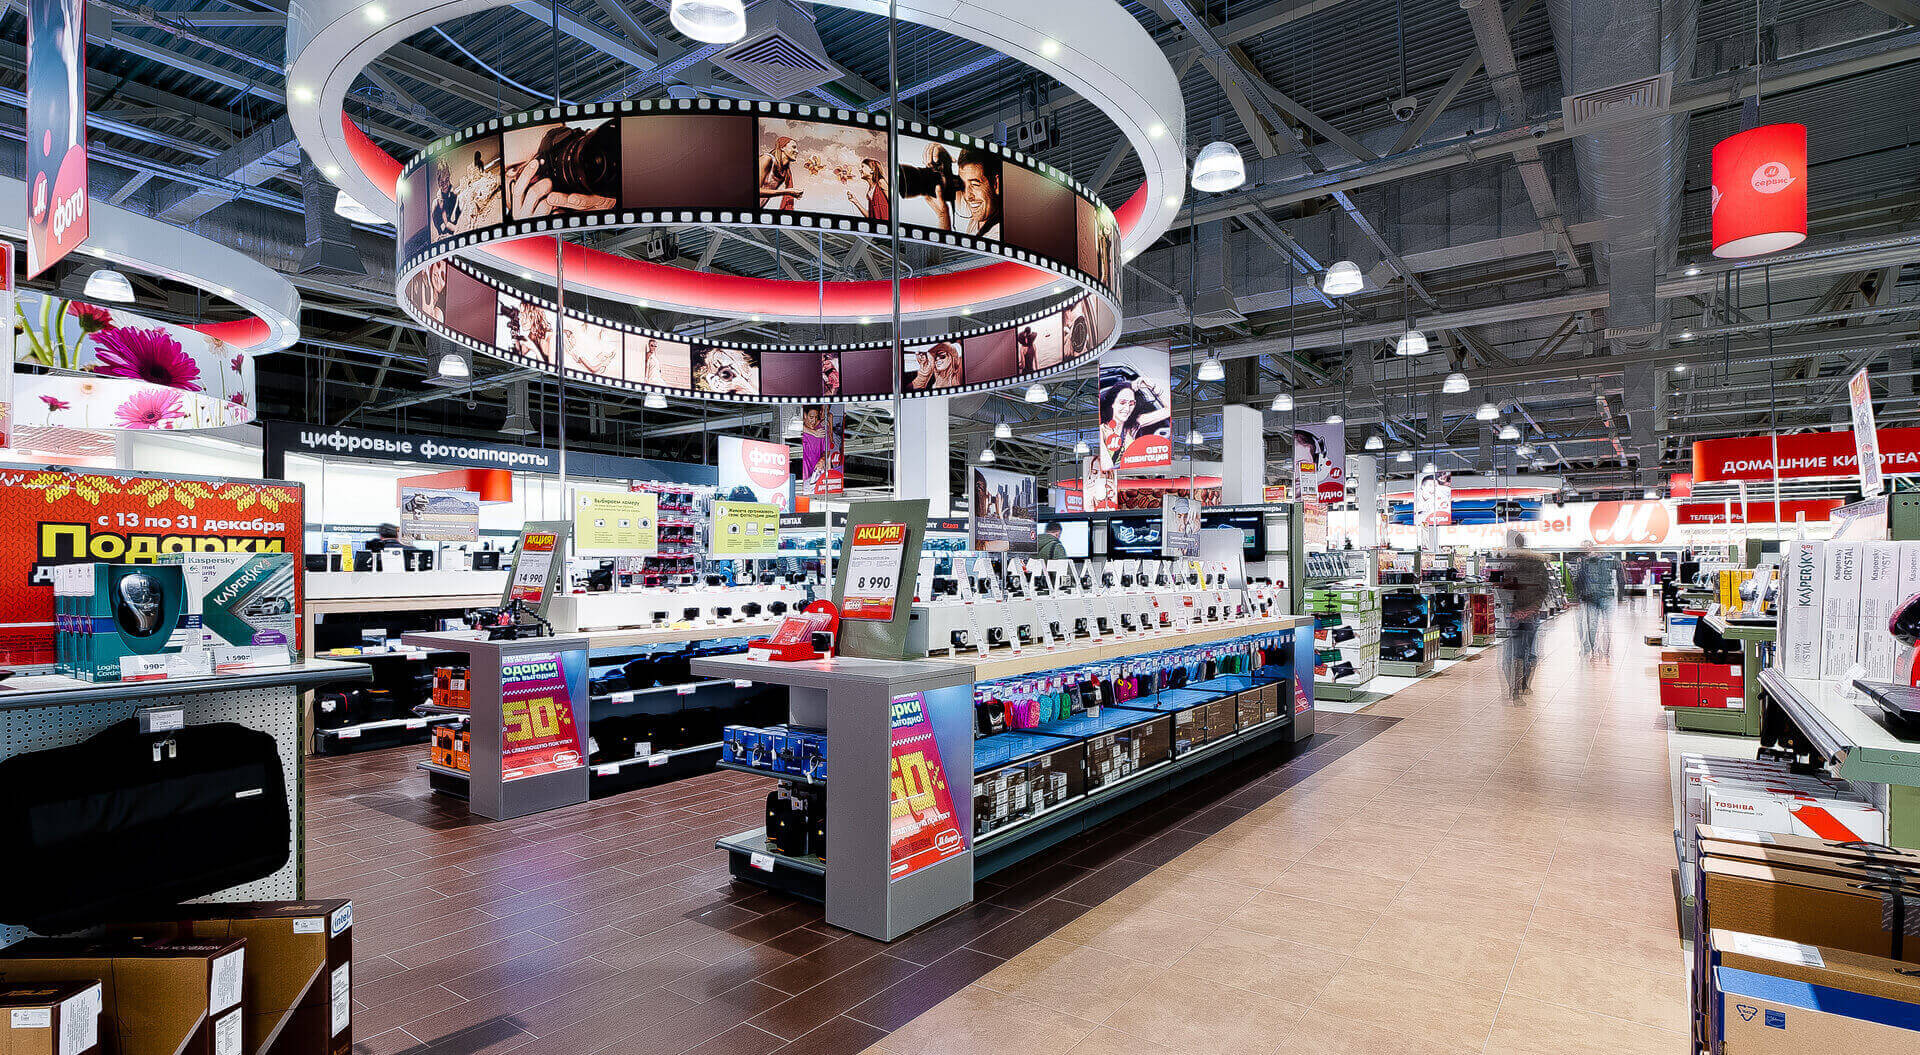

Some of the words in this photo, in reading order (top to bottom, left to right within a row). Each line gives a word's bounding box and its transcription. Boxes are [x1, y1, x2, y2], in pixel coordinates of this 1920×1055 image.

[1754, 178, 1789, 187] сервис
[54, 187, 84, 245] фото
[300, 430, 413, 452] цифровые
[420, 439, 549, 467] фотоаппараты
[748, 446, 787, 467] фото
[1124, 453, 1169, 464] навигация
[1721, 455, 1827, 474] ДОМАШНИЕ
[97, 514, 109, 526] с
[116, 512, 139, 527] 13
[144, 516, 172, 528] по
[176, 515, 197, 529] 31
[203, 517, 286, 534] декабря
[1690, 513, 1744, 521] ТЕЛЕВИЗРЫ
[526, 535, 555, 546] АКЦИЯ!
[857, 526, 901, 542] АКЦИЯ!
[42, 524, 282, 564] Подарки
[188, 557, 236, 565] Kaspersky
[1833, 549, 1843, 581] Kaspersky
[1843, 546, 1854, 581] CRYSTAL
[1870, 548, 1881, 581] Kaspersky
[213, 562, 263, 606] KASPERSKY
[519, 573, 528, 582] 14
[530, 573, 543, 583] 990
[858, 576, 866, 589] 8
[869, 576, 891, 589] 990
[1797, 550, 1816, 607] KASPERSKY
[97, 664, 120, 672] Logite
[502, 662, 557, 677] одарки
[502, 676, 520, 684] рить
[521, 671, 559, 681] выгодно!
[511, 743, 548, 753] СЛЕДУЮЩУЮ
[548, 738, 573, 747] ПОКУПКУ
[1714, 801, 1755, 811] TOSHIBA
[334, 912, 350, 929] intel
